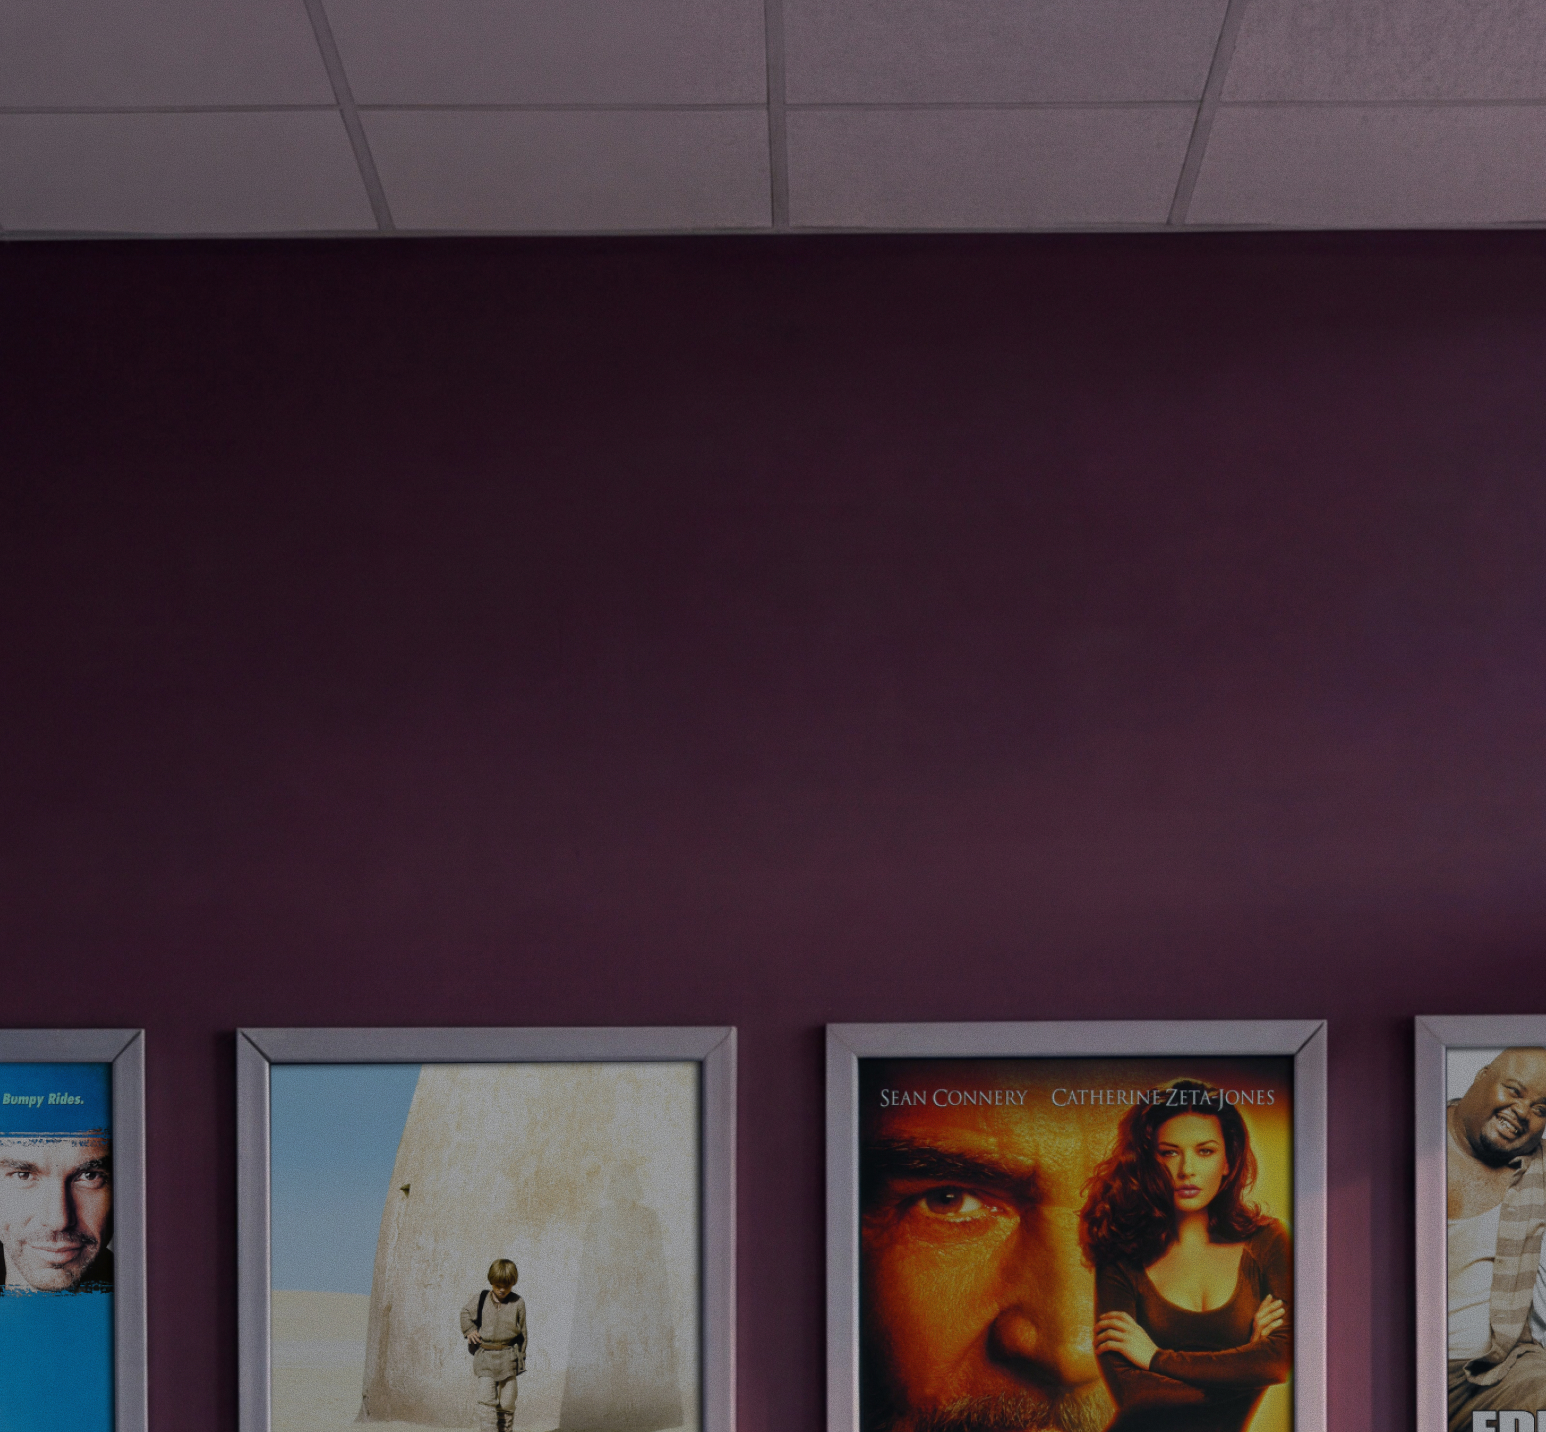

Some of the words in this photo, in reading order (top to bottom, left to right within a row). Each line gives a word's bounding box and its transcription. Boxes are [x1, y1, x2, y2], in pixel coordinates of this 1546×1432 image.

[2, 1092, 44, 1109] Bumpy
[48, 1092, 85, 1106] Rides.
[880, 1088, 927, 1107] SEAN
[933, 1088, 1028, 1107] CONNERY
[1051, 1088, 1161, 1107] CATHERINE
[1165, 1088, 1276, 1110] ZETA-JONES
